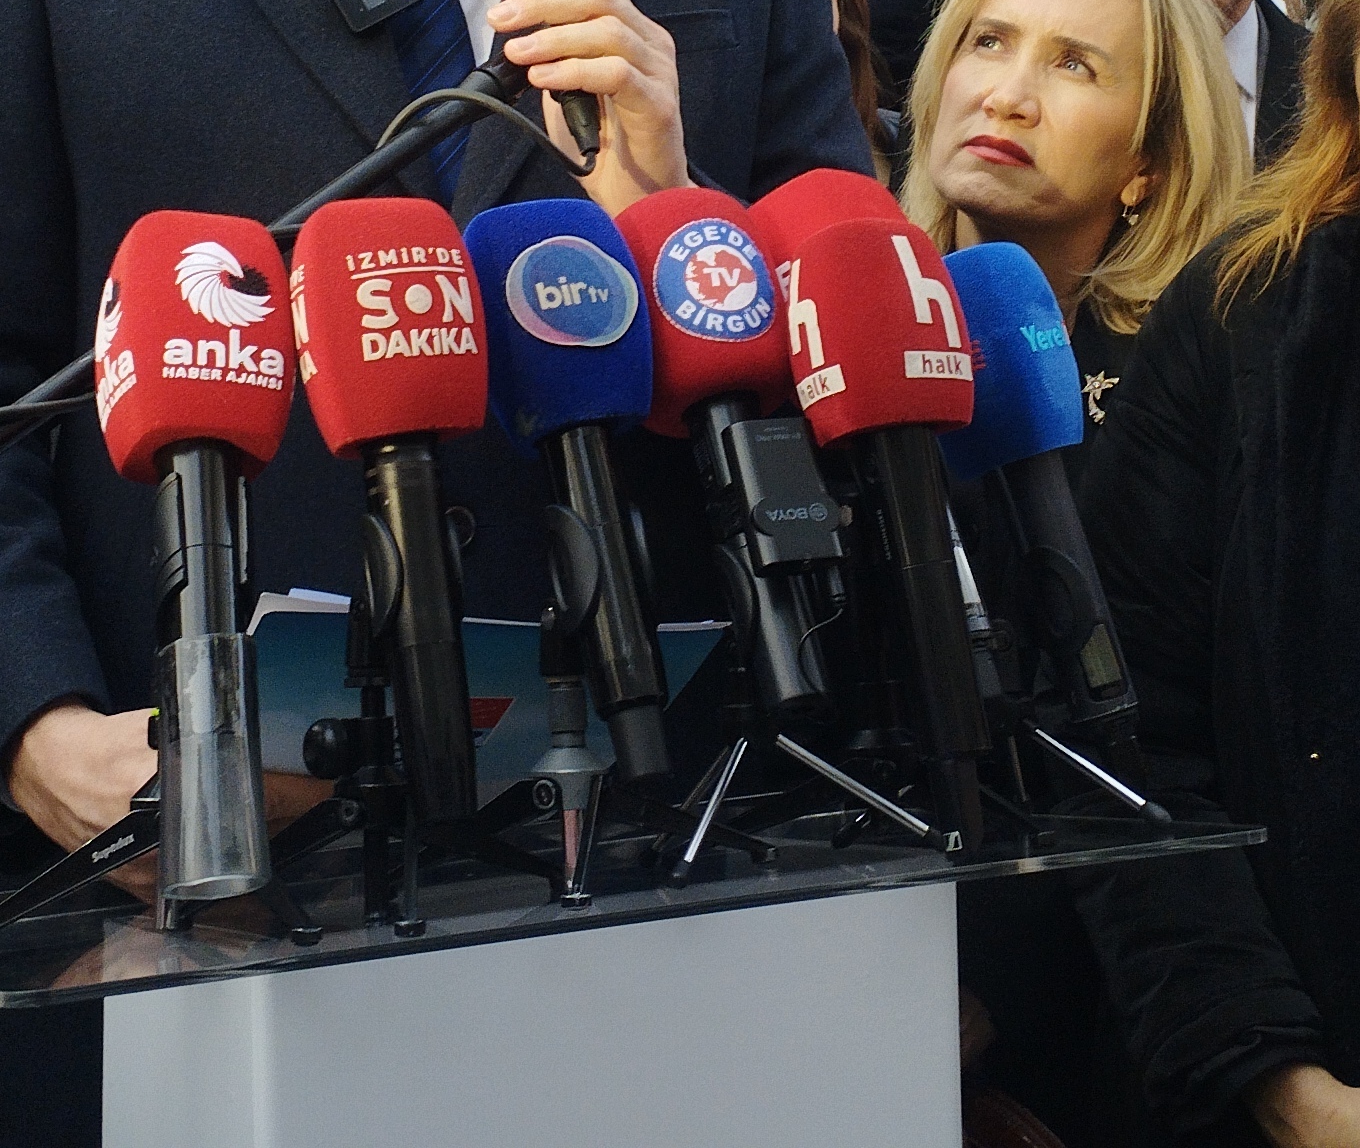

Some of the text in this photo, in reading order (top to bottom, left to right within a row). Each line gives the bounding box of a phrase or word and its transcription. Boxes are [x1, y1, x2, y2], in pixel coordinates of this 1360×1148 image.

[704, 266, 741, 289] TV
[163, 328, 285, 377] anka
[921, 352, 963, 376] halk
[162, 366, 283, 390] HABER AJANSI
[800, 374, 831, 400] alk
